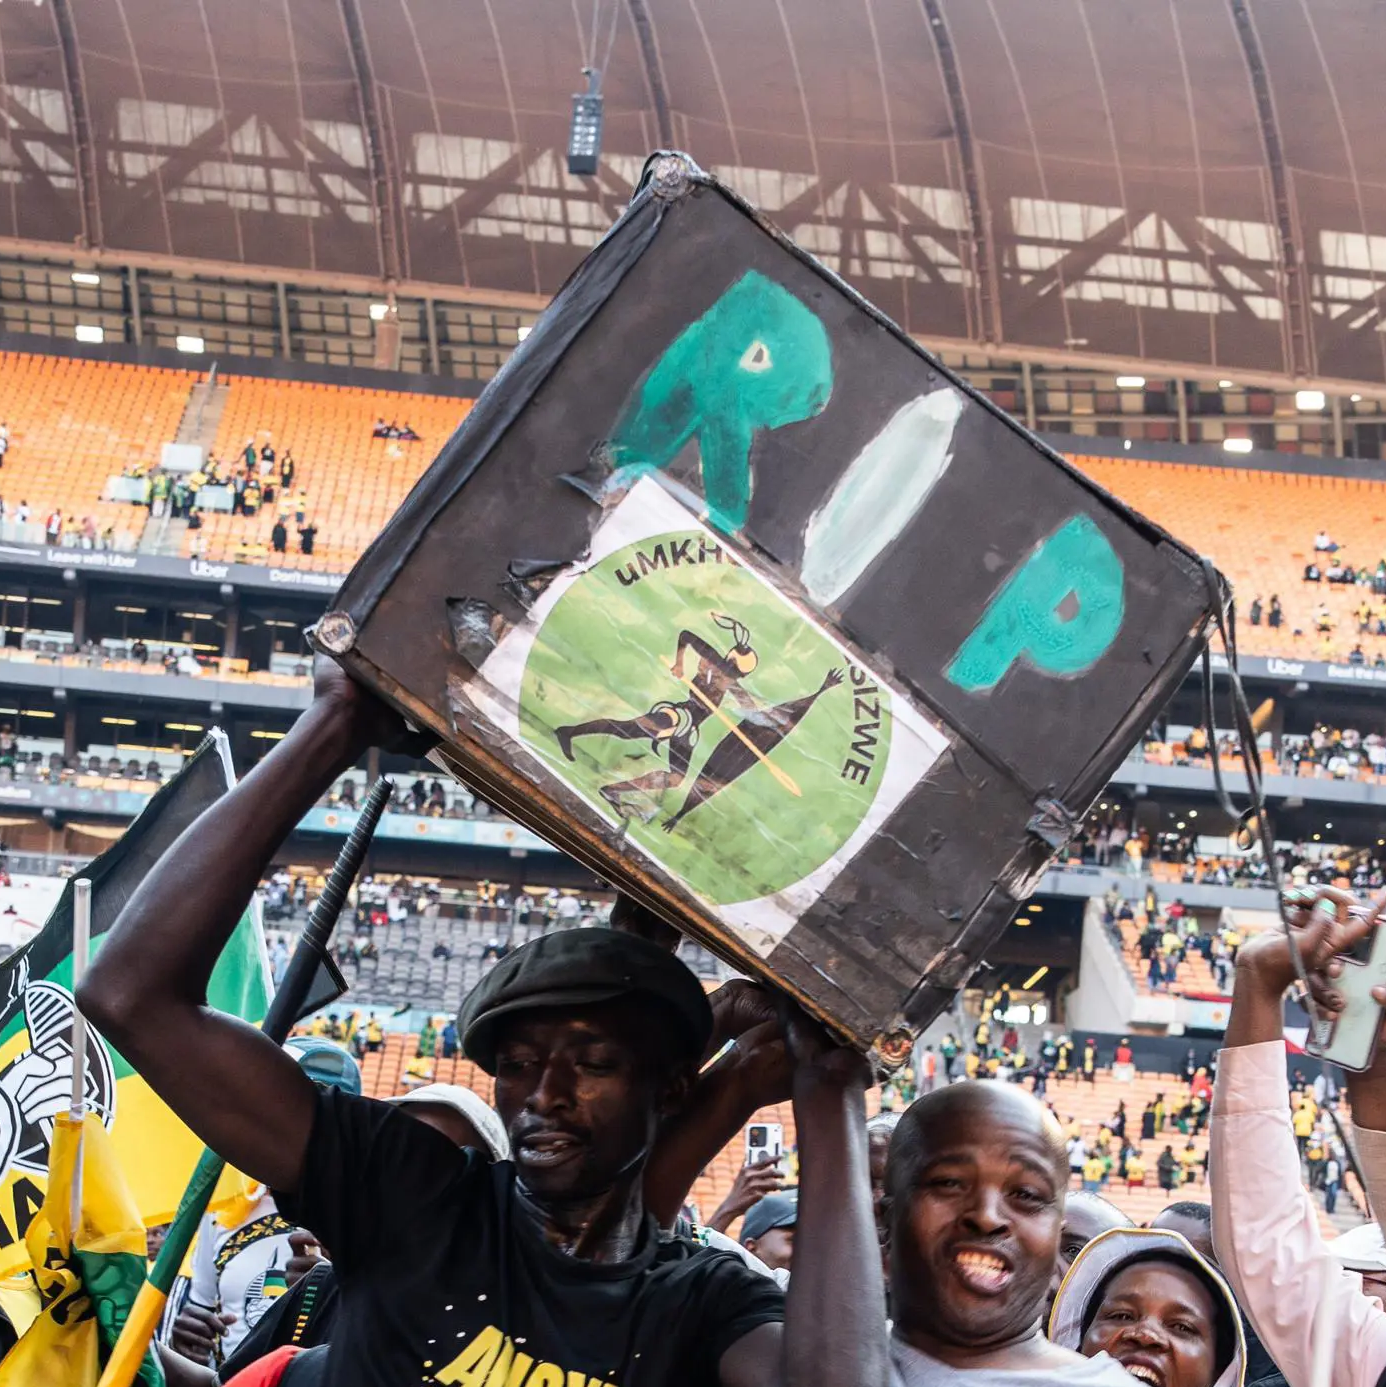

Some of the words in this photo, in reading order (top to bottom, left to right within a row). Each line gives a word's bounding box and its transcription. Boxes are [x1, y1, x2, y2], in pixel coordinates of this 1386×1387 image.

[613, 271, 1125, 692] RIP
[47, 549, 82, 564] Leave
[82, 552, 107, 566] with
[108, 554, 137, 568] Uber
[190, 560, 229, 578] Uber
[269, 569, 301, 584] Don't
[1267, 658, 1304, 676] Uber
[841, 662, 881, 786] SIZWE
